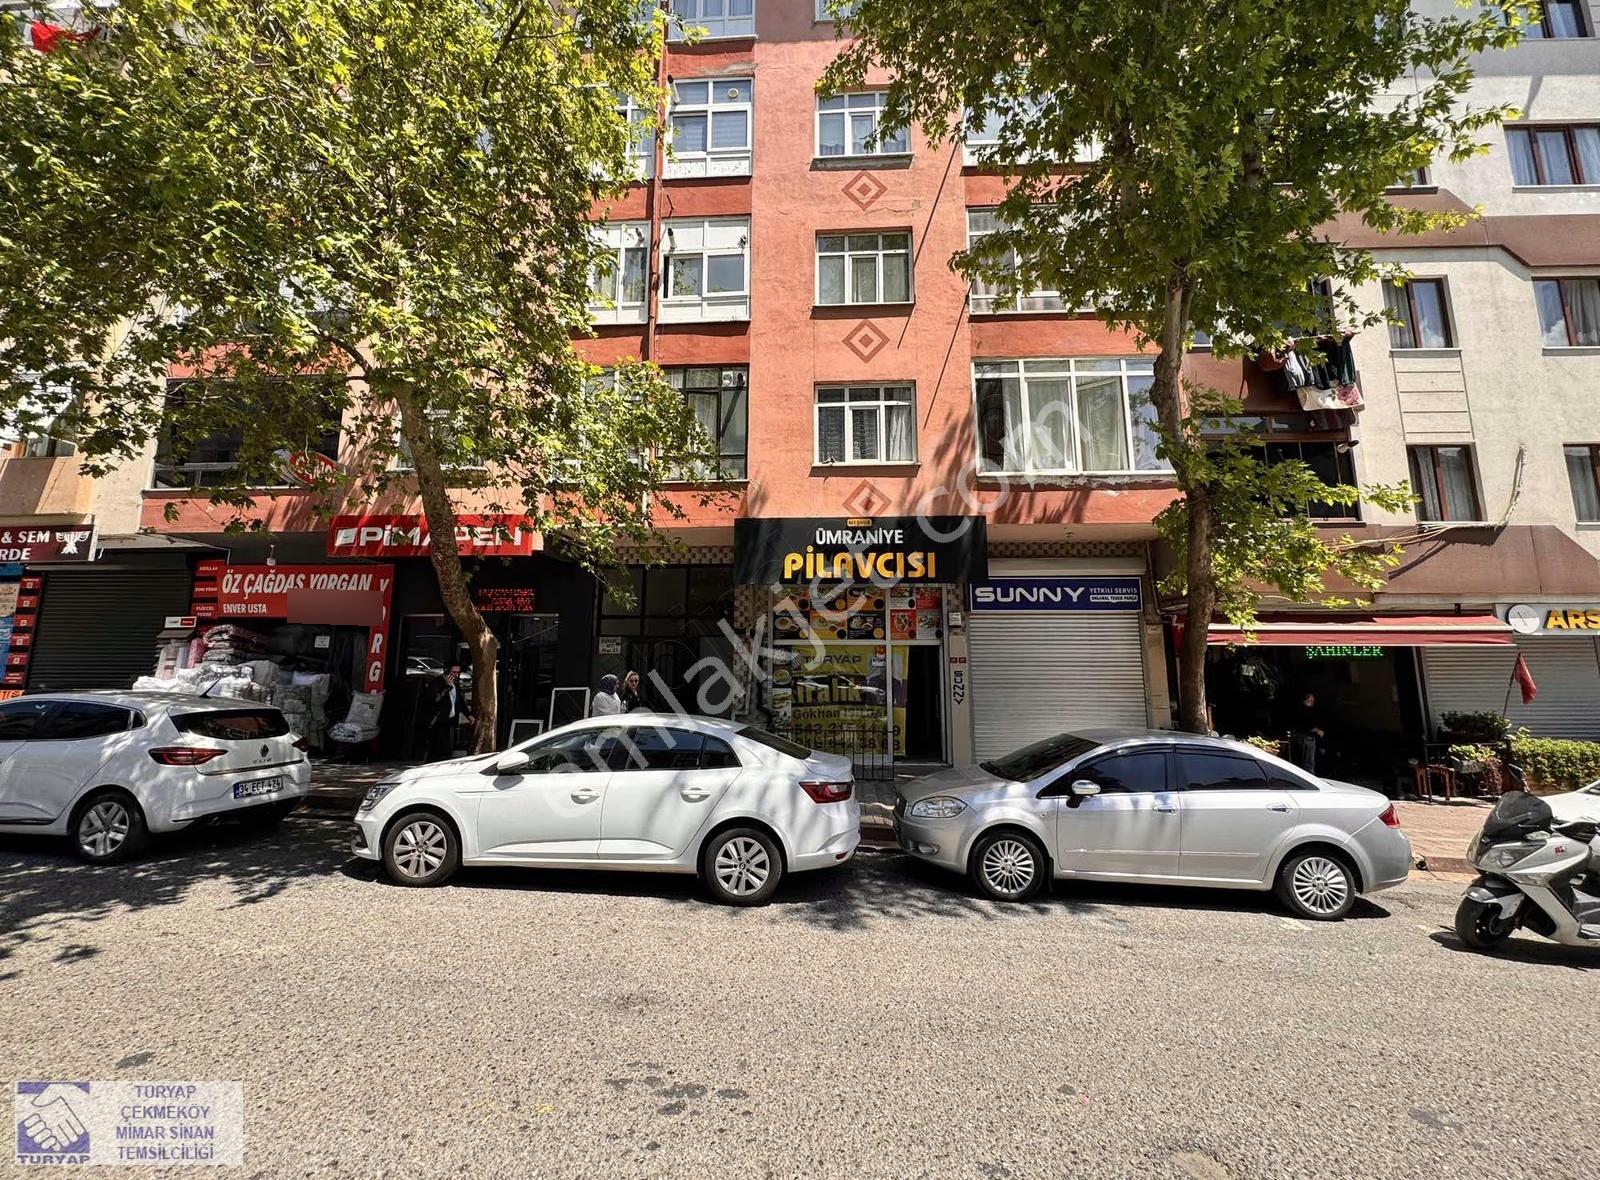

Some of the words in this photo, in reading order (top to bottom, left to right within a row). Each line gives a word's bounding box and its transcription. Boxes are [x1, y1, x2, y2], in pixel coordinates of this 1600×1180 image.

[1, 531, 12, 543] &
[18, 530, 51, 543] SEM
[815, 528, 904, 545] ÜMRANİYE
[783, 545, 936, 579] PİLAVCISI
[222, 568, 243, 594] ÖZ
[974, 586, 1086, 603] SUNNY
[223, 603, 246, 613] ENVER
[247, 603, 267, 613] USTA
[953, 670, 965, 705] SUNNY
[240, 784, 248, 793] 34
